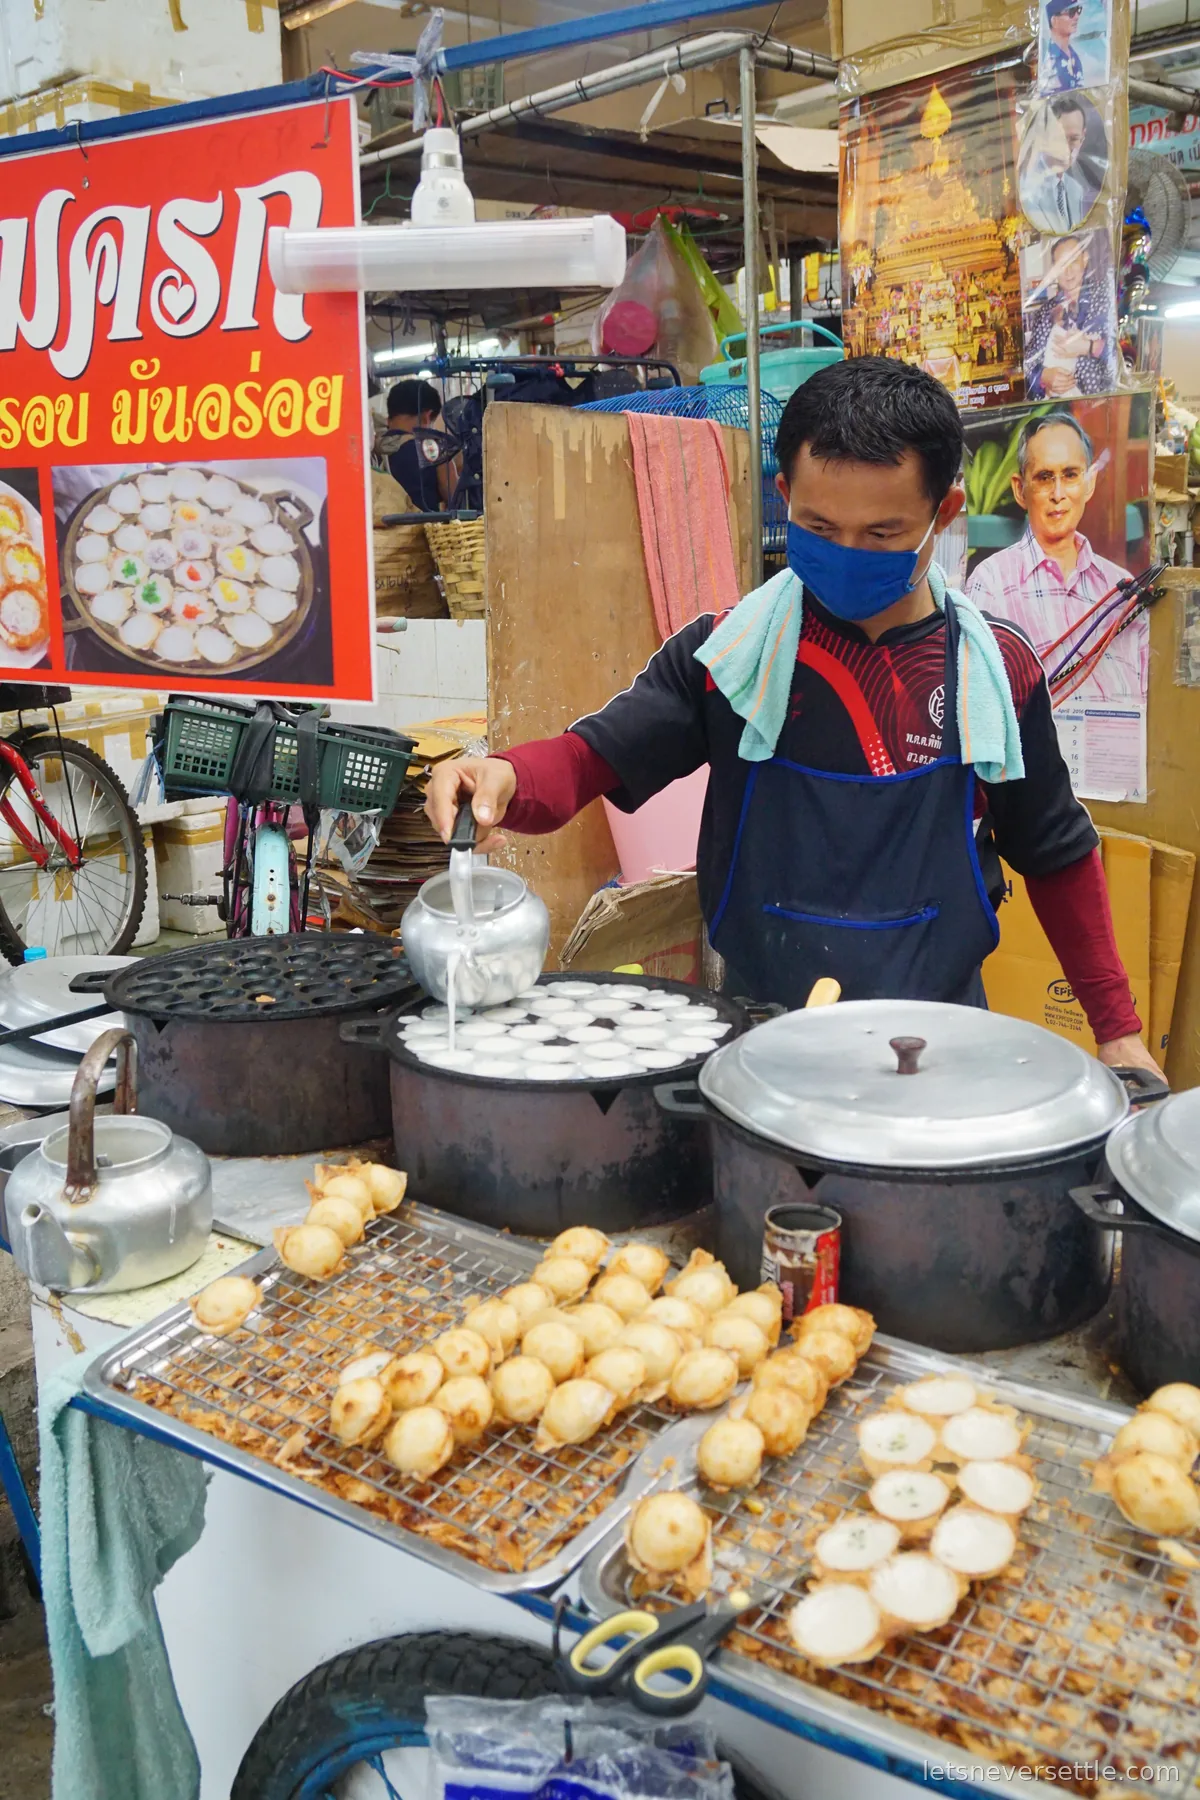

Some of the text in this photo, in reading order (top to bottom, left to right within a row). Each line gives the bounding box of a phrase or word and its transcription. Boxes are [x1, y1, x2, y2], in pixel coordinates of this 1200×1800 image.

[111, 351, 344, 445] มันอร่อย
[1070, 767, 1079, 775] 23
